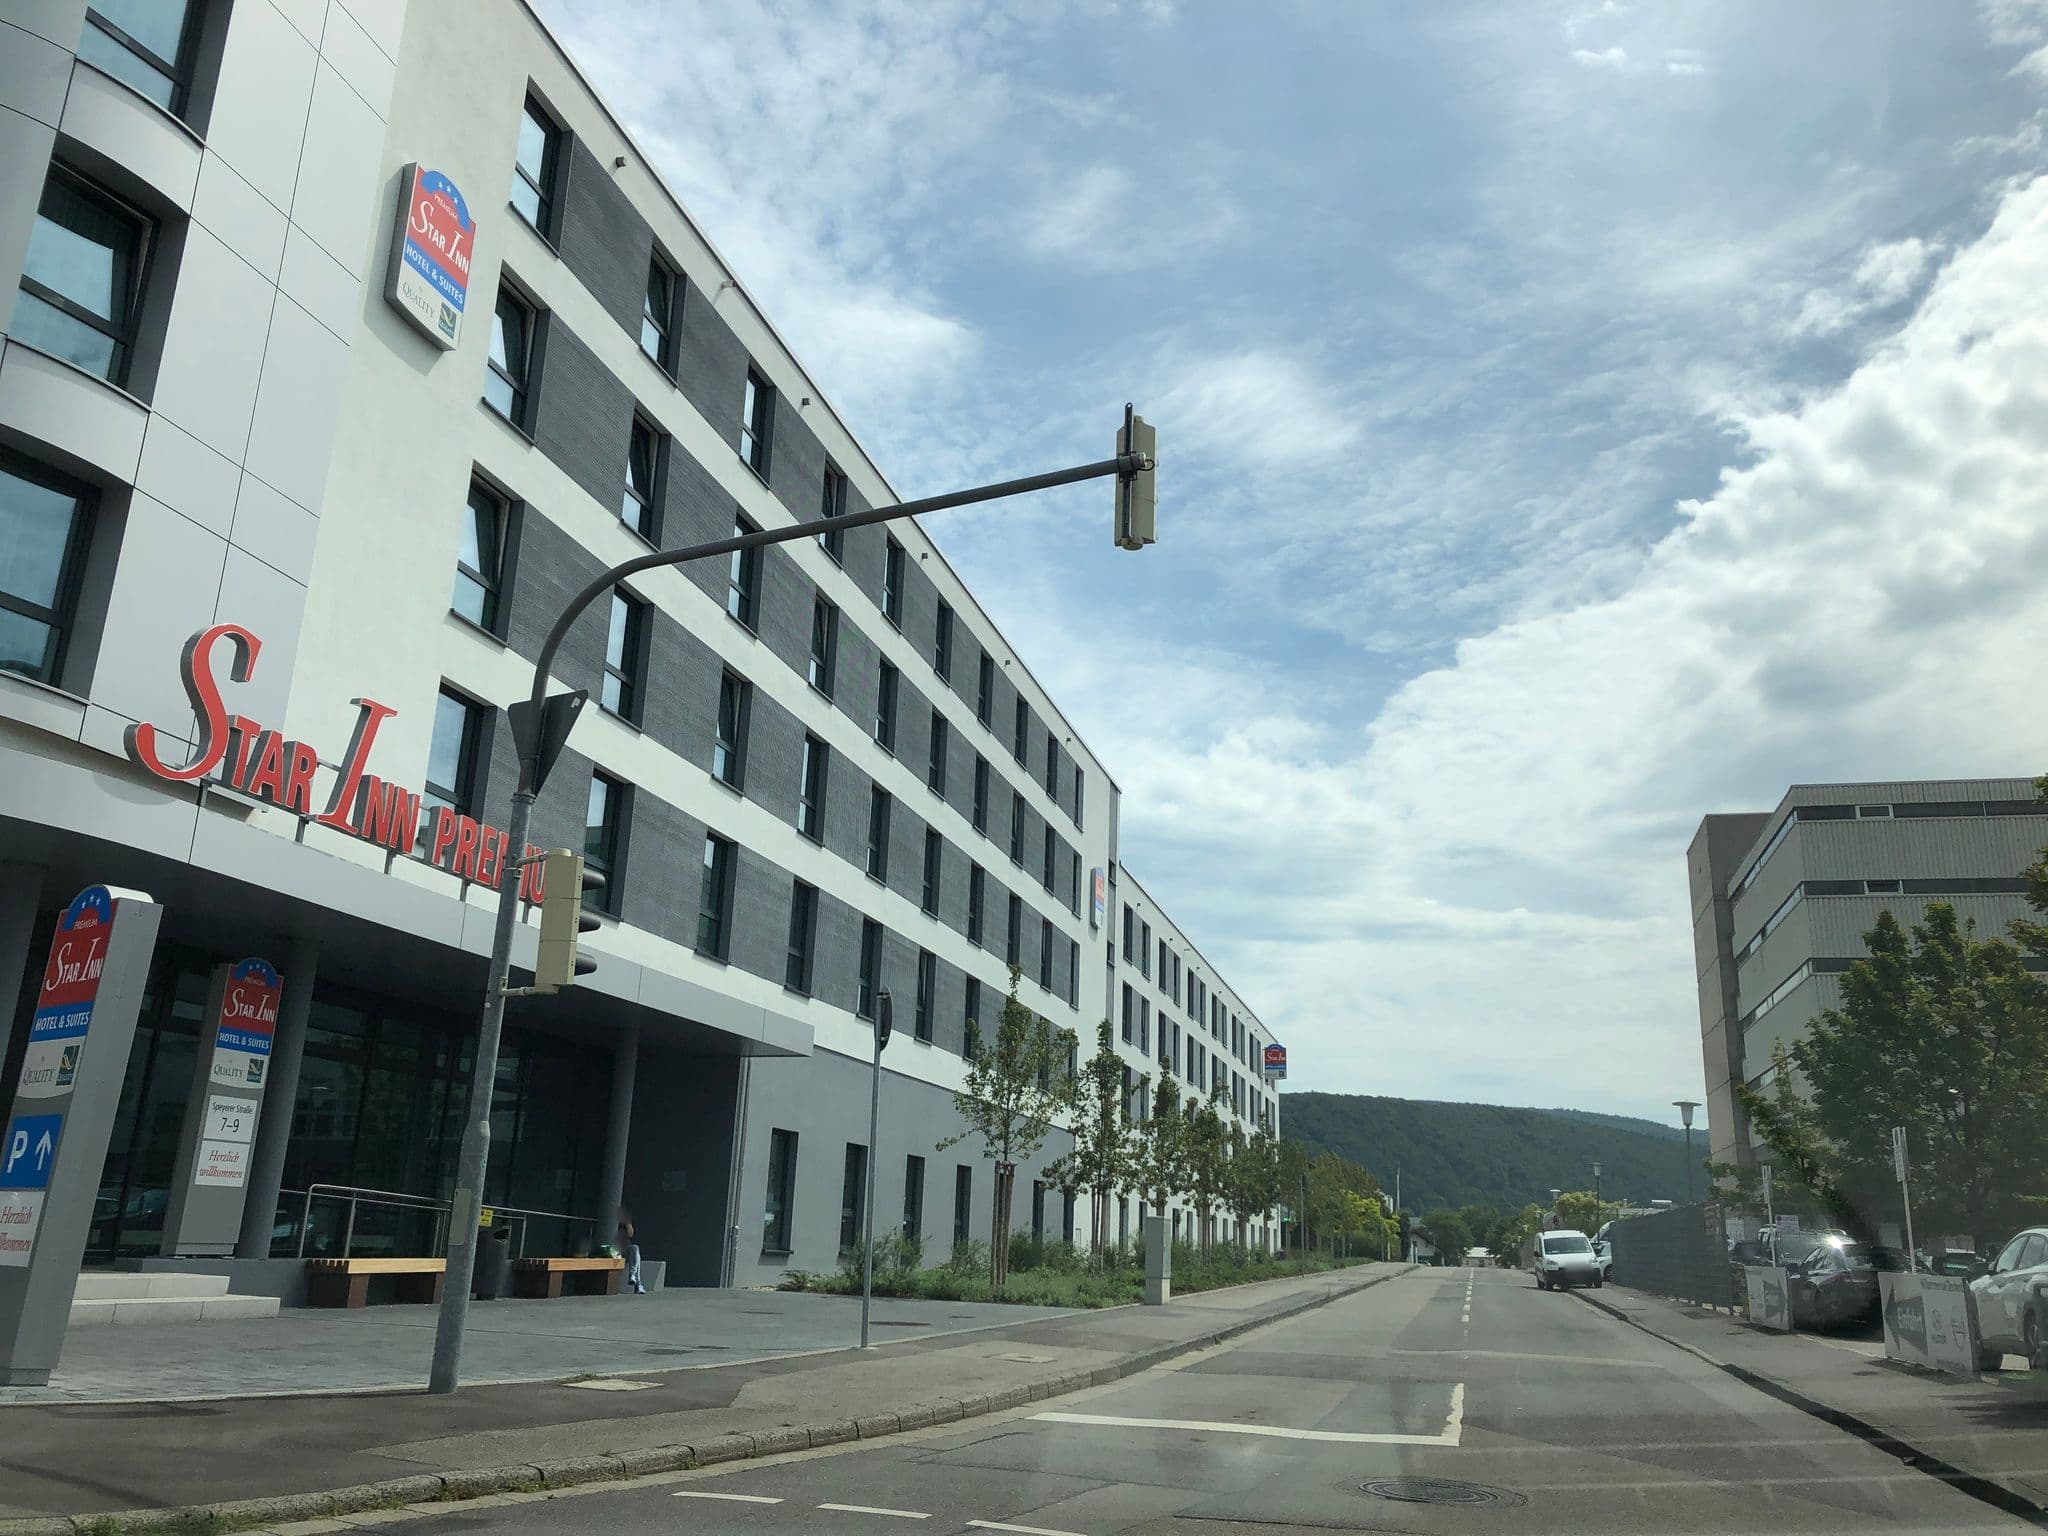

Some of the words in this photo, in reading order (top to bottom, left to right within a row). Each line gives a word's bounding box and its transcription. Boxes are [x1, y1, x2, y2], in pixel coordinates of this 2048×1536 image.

[411, 200, 446, 252] STAR
[445, 230, 470, 275] INN
[405, 244, 431, 274] HOTEL
[431, 268, 438, 282] &
[438, 275, 464, 304] SUITES
[402, 281, 435, 318] QUALITY
[124, 622, 317, 814] STAR
[316, 697, 421, 854] INN
[432, 805, 545, 904] PREIU
[73, 918, 98, 930] PREMIUM
[45, 942, 81, 991] STAR
[78, 936, 104, 982] INN
[224, 988, 255, 1017] STAR
[254, 994, 275, 1023] INN
[35, 1016, 58, 1031] HOTEL
[59, 1015, 65, 1029] &
[65, 1011, 90, 1027] SUITES
[219, 1032, 240, 1045] HOTEL
[241, 1036, 247, 1046] &
[247, 1038, 269, 1049] SUITES
[22, 1067, 56, 1086] QUALITY
[213, 1063, 244, 1078] QUALITY
[212, 1102, 236, 1113] Speyerer
[236, 1104, 254, 1114] Straße
[6, 1130, 29, 1173] P
[209, 1149, 240, 1162] Herzlich
[199, 1165, 243, 1178] willkommen
[0, 1206, 32, 1224] Herzlich
